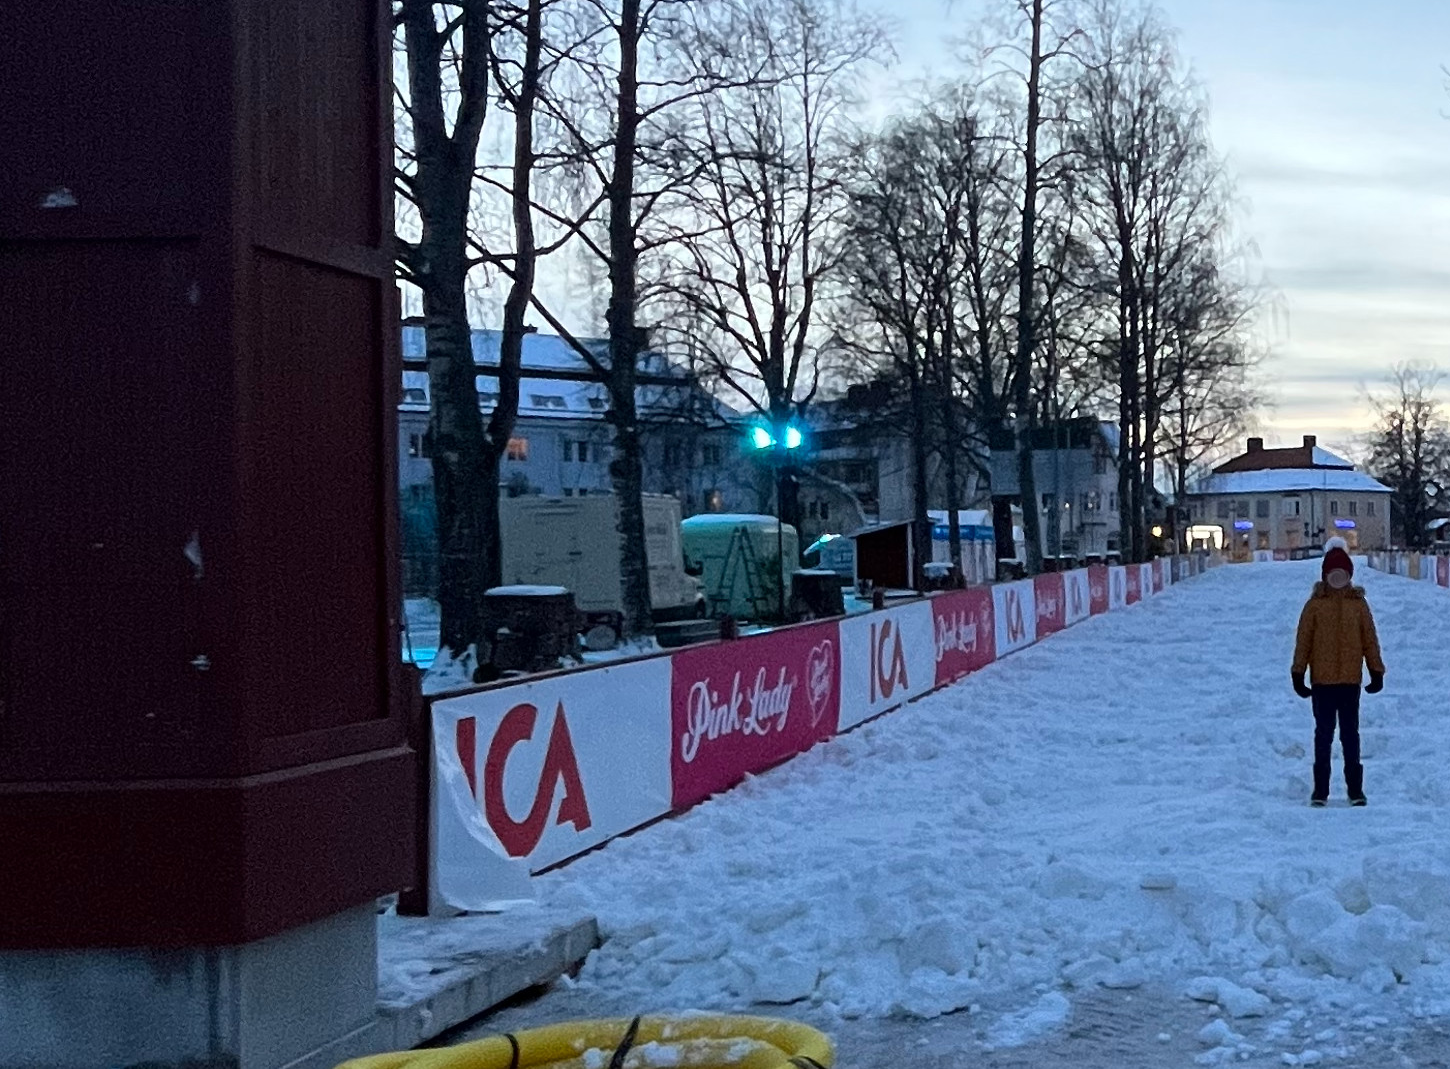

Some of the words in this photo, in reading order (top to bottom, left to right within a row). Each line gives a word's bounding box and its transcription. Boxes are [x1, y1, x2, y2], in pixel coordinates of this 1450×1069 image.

[870, 619, 908, 704] ICA
[682, 671, 742, 763] Pink
[456, 699, 592, 857] ICA
